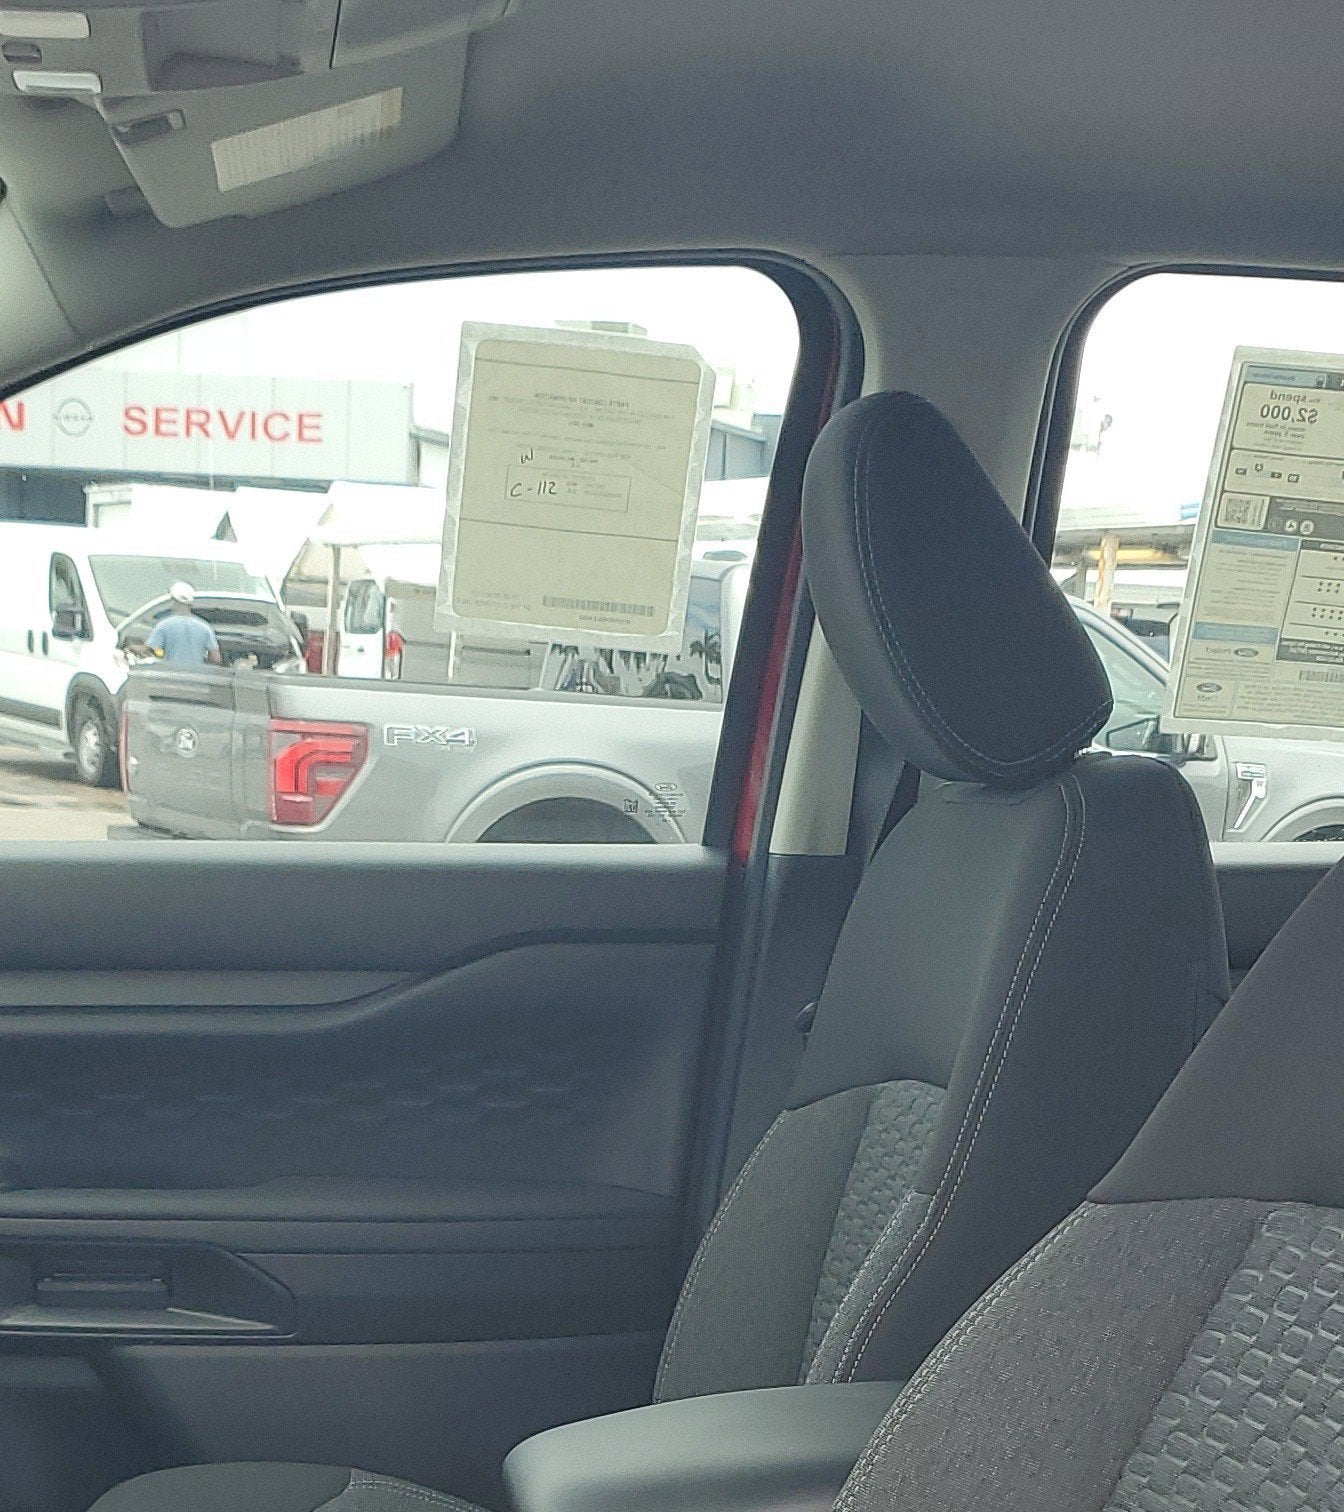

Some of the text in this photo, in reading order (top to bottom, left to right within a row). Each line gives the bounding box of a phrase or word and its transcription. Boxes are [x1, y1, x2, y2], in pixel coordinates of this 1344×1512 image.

[122, 404, 324, 443] SERVICE
[510, 480, 557, 498] C-112
[383, 723, 477, 747] FX4
